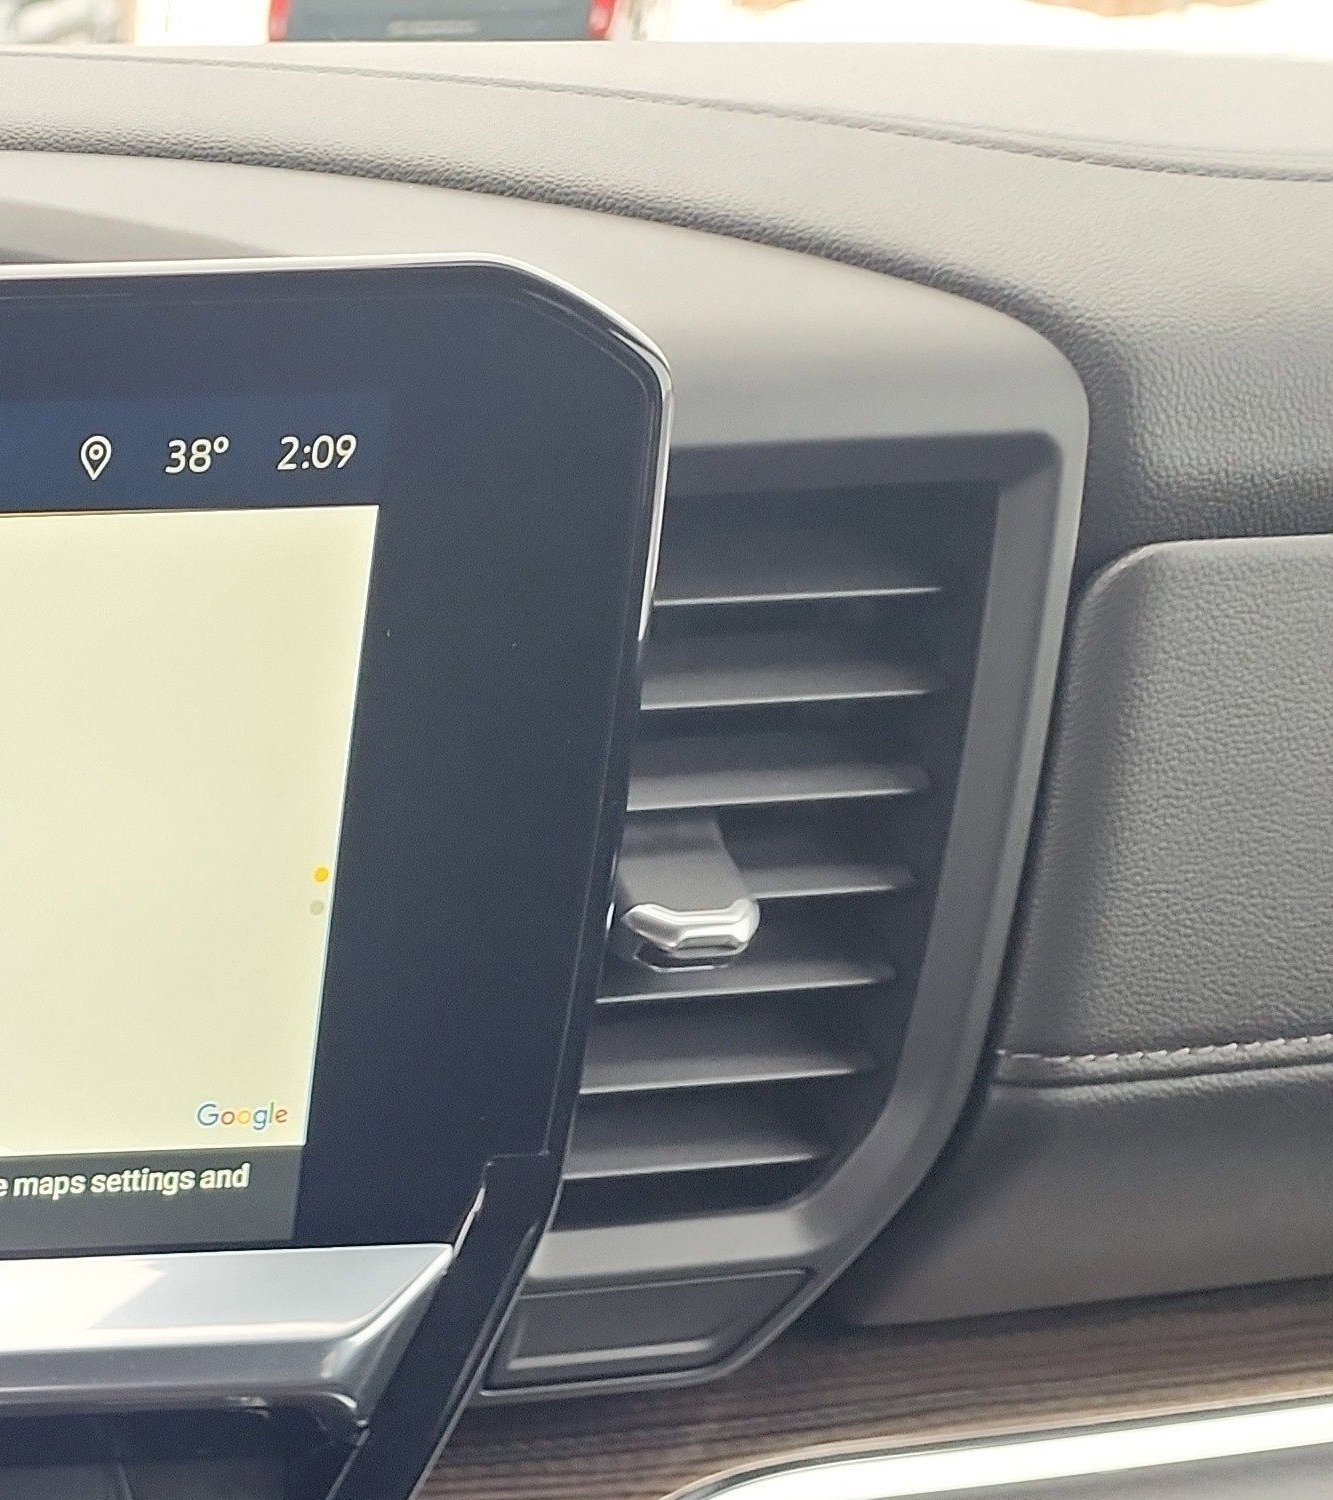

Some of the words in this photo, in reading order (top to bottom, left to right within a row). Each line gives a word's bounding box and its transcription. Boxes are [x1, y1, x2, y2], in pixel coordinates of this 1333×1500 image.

[276, 434, 357, 471] 2:09
[195, 1101, 290, 1133] Google
[12, 1175, 87, 1201] maps
[90, 1167, 196, 1196] settings
[199, 1162, 251, 1190] and
